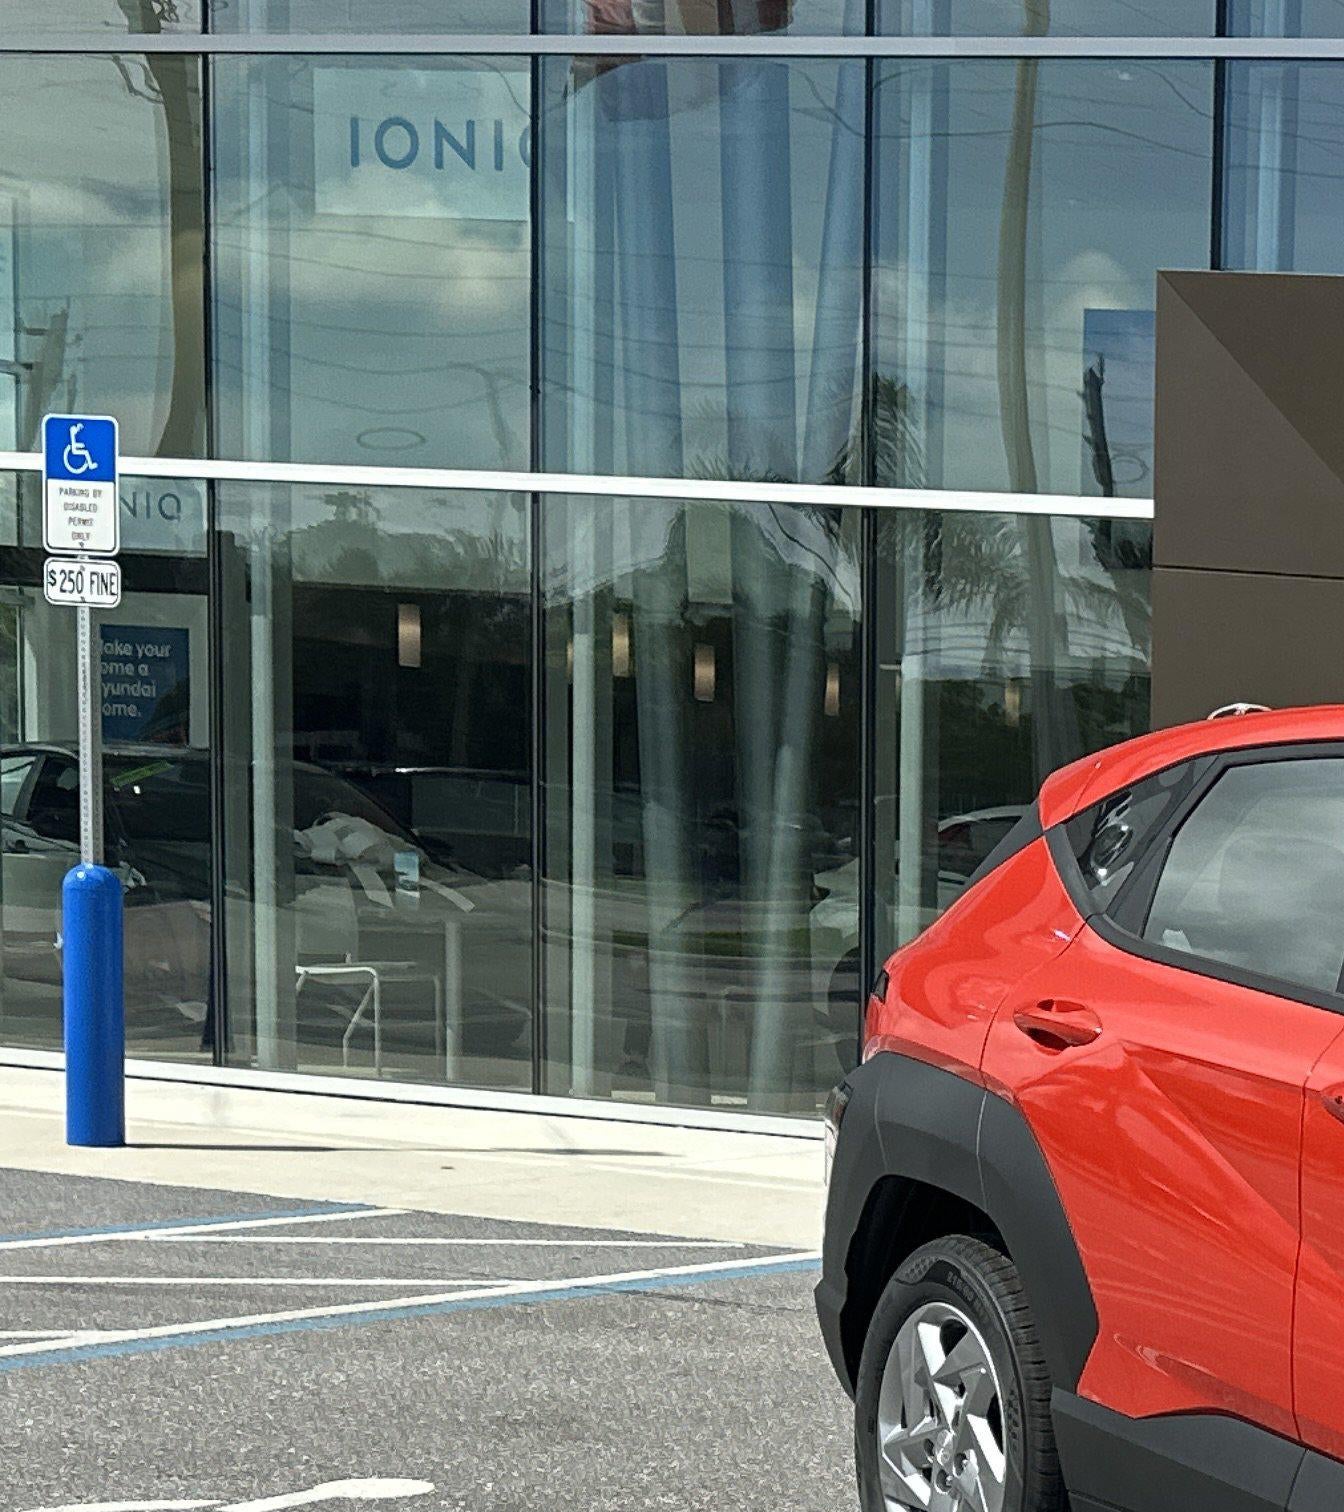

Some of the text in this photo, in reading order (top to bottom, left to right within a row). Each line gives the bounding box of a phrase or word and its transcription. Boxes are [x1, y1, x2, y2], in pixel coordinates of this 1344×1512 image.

[350, 116, 531, 171] IONI
[120, 491, 182, 522] NIQ
[48, 569, 118, 596] $250 FINE
[135, 642, 171, 659] your
[100, 661, 149, 676] ome a
[101, 680, 157, 698] yundai
[101, 703, 141, 716] ome.
